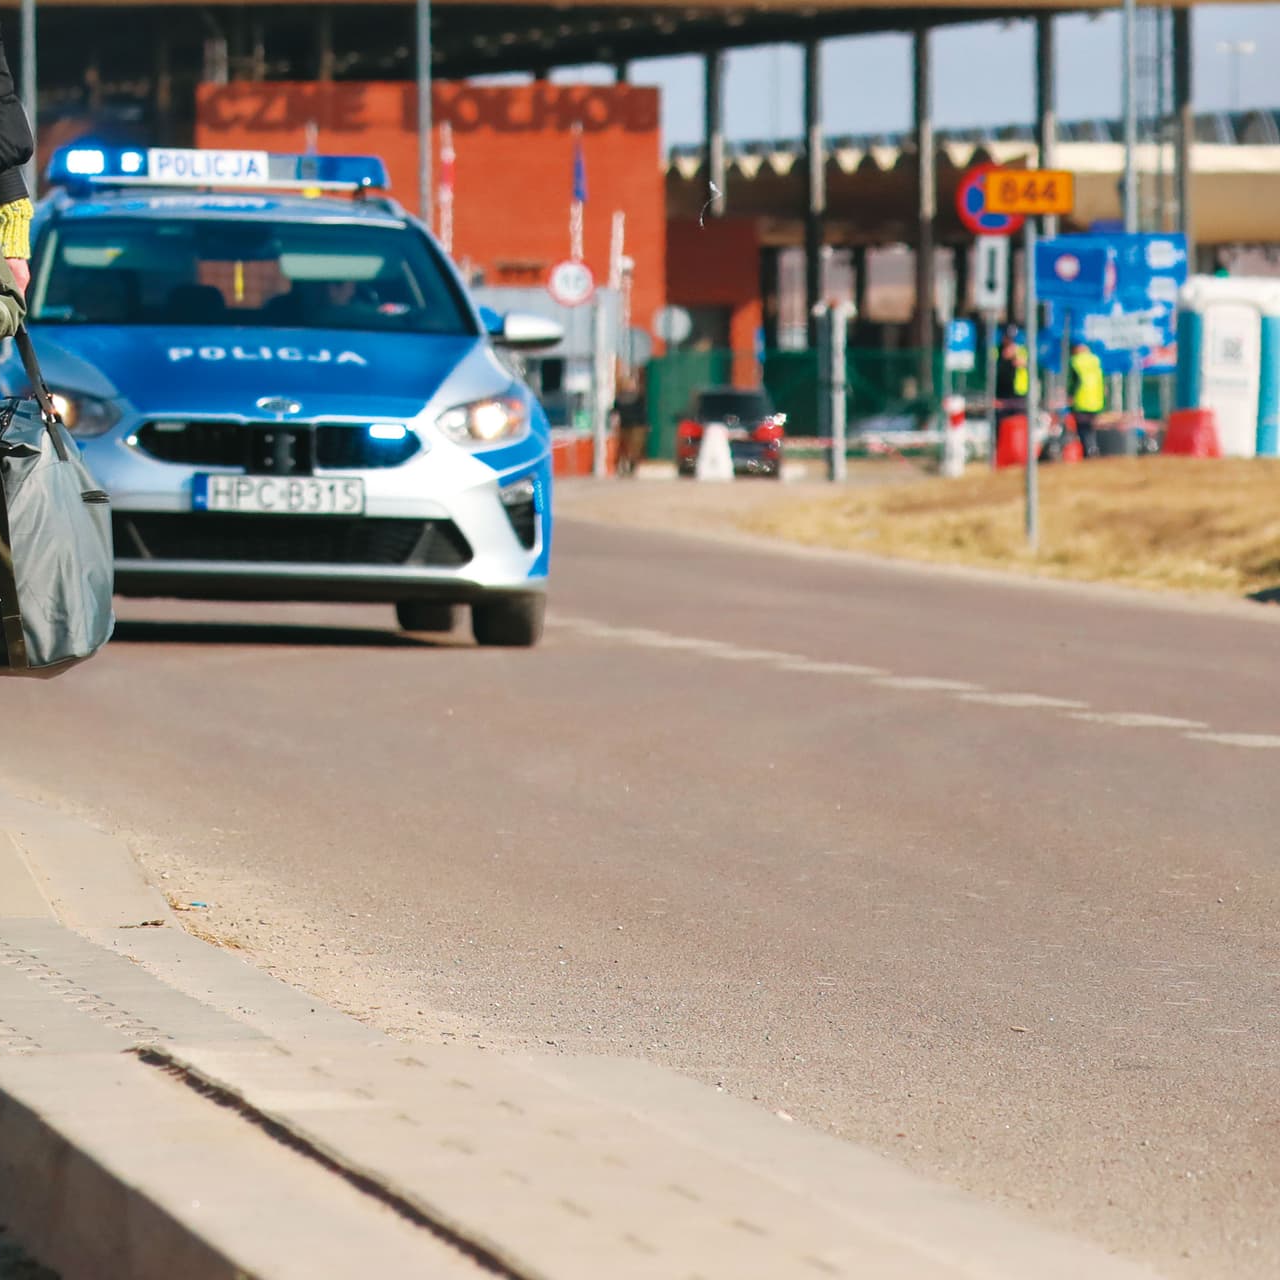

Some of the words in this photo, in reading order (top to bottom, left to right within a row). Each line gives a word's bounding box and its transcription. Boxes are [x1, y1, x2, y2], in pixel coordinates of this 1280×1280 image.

[157, 152, 261, 177] POLICJA
[999, 178, 1058, 204] 844
[168, 346, 368, 366] POLICJA
[212, 479, 275, 509] HPC
